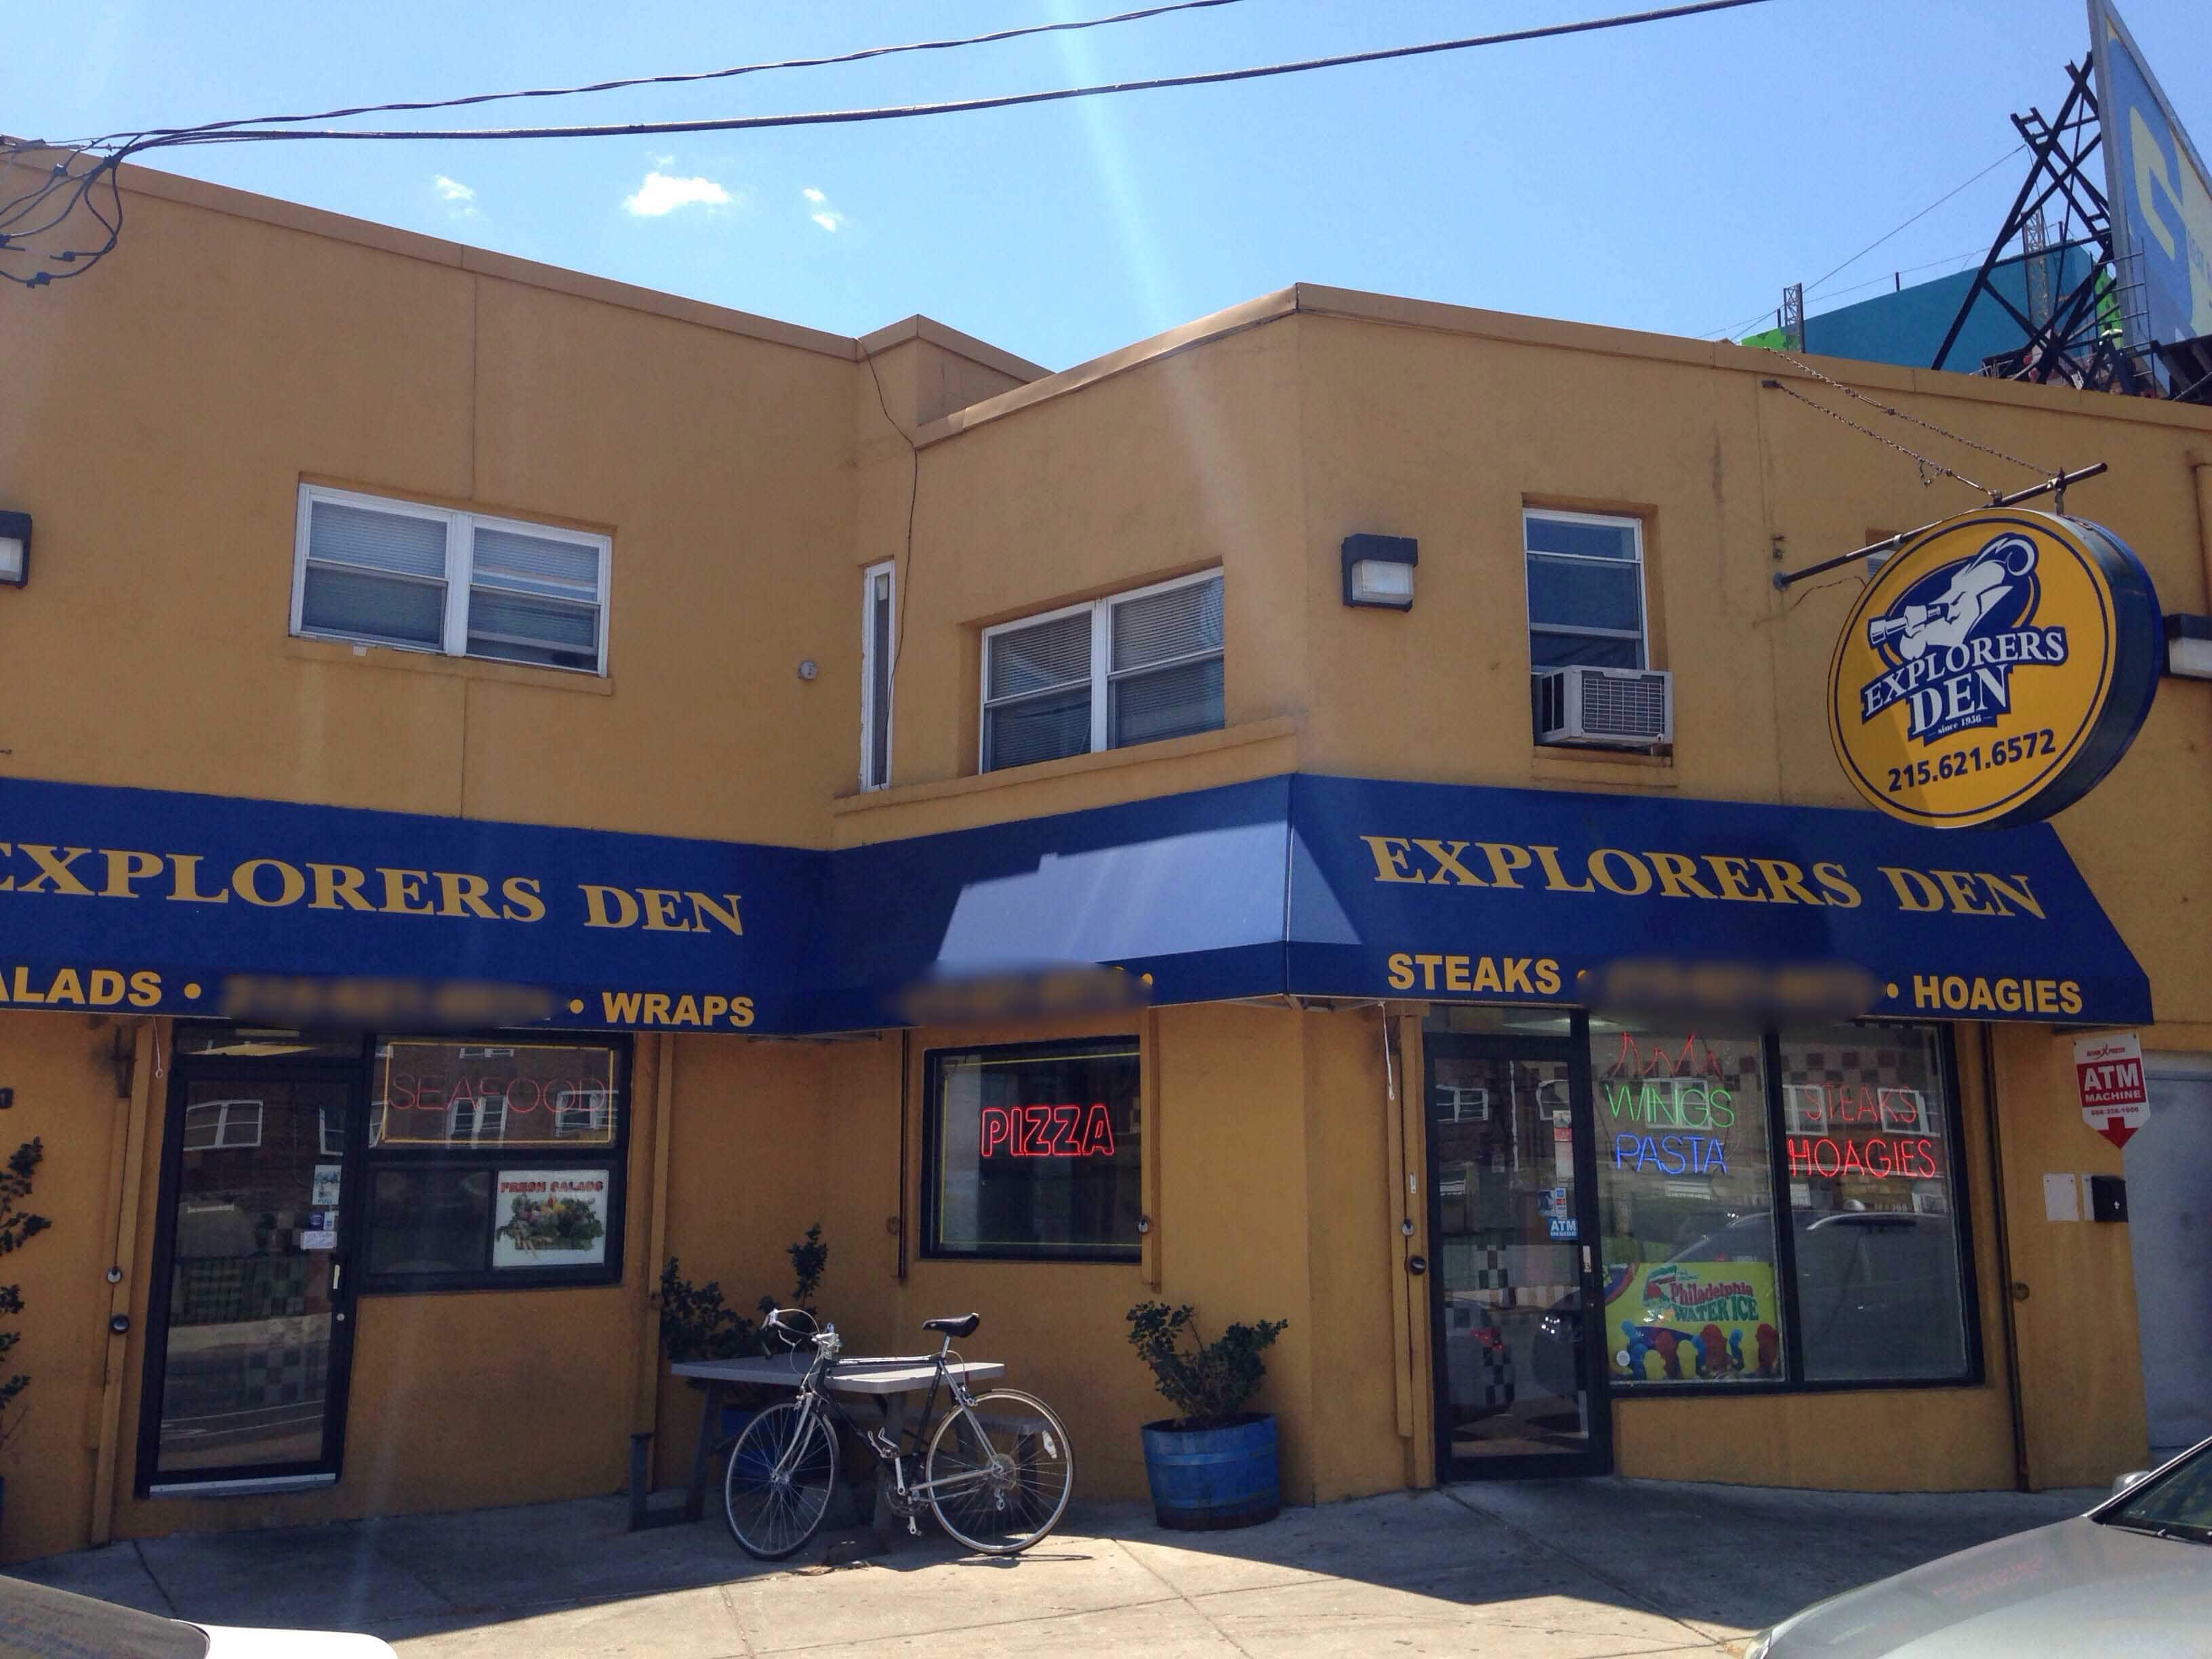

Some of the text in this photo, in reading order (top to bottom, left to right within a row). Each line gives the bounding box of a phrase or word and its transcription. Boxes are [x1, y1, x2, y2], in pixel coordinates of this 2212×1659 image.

[1864, 631, 2065, 716] EXPLORERS
[1909, 663, 2009, 736] DEN
[1888, 729, 2055, 792] 215.621.6572
[0, 842, 744, 936] XPLORERS DEN
[1359, 835, 2046, 920] EXPLORERS DEN
[0, 966, 163, 1006] LADS
[1387, 952, 1561, 996] STEAKS
[1912, 974, 2083, 1015] HOAGIES
[602, 991, 755, 1027] WRAPS
[388, 1073, 606, 1113] SEAFOOD
[2084, 1063, 2139, 1091] ATM
[2085, 1090, 2142, 1102] MACHINE
[1605, 1084, 1735, 1128] WINGS
[1804, 1082, 1917, 1123] STEAKS
[981, 1103, 1115, 1158] PIZZA
[1615, 1132, 1728, 1175] PASTA
[1787, 1137, 1936, 1179] HOAGIES
[1551, 1220, 1577, 1231] ATM
[1669, 1281, 1754, 1305] Philadelphia
[1673, 1294, 1759, 1322] WATER ICE
